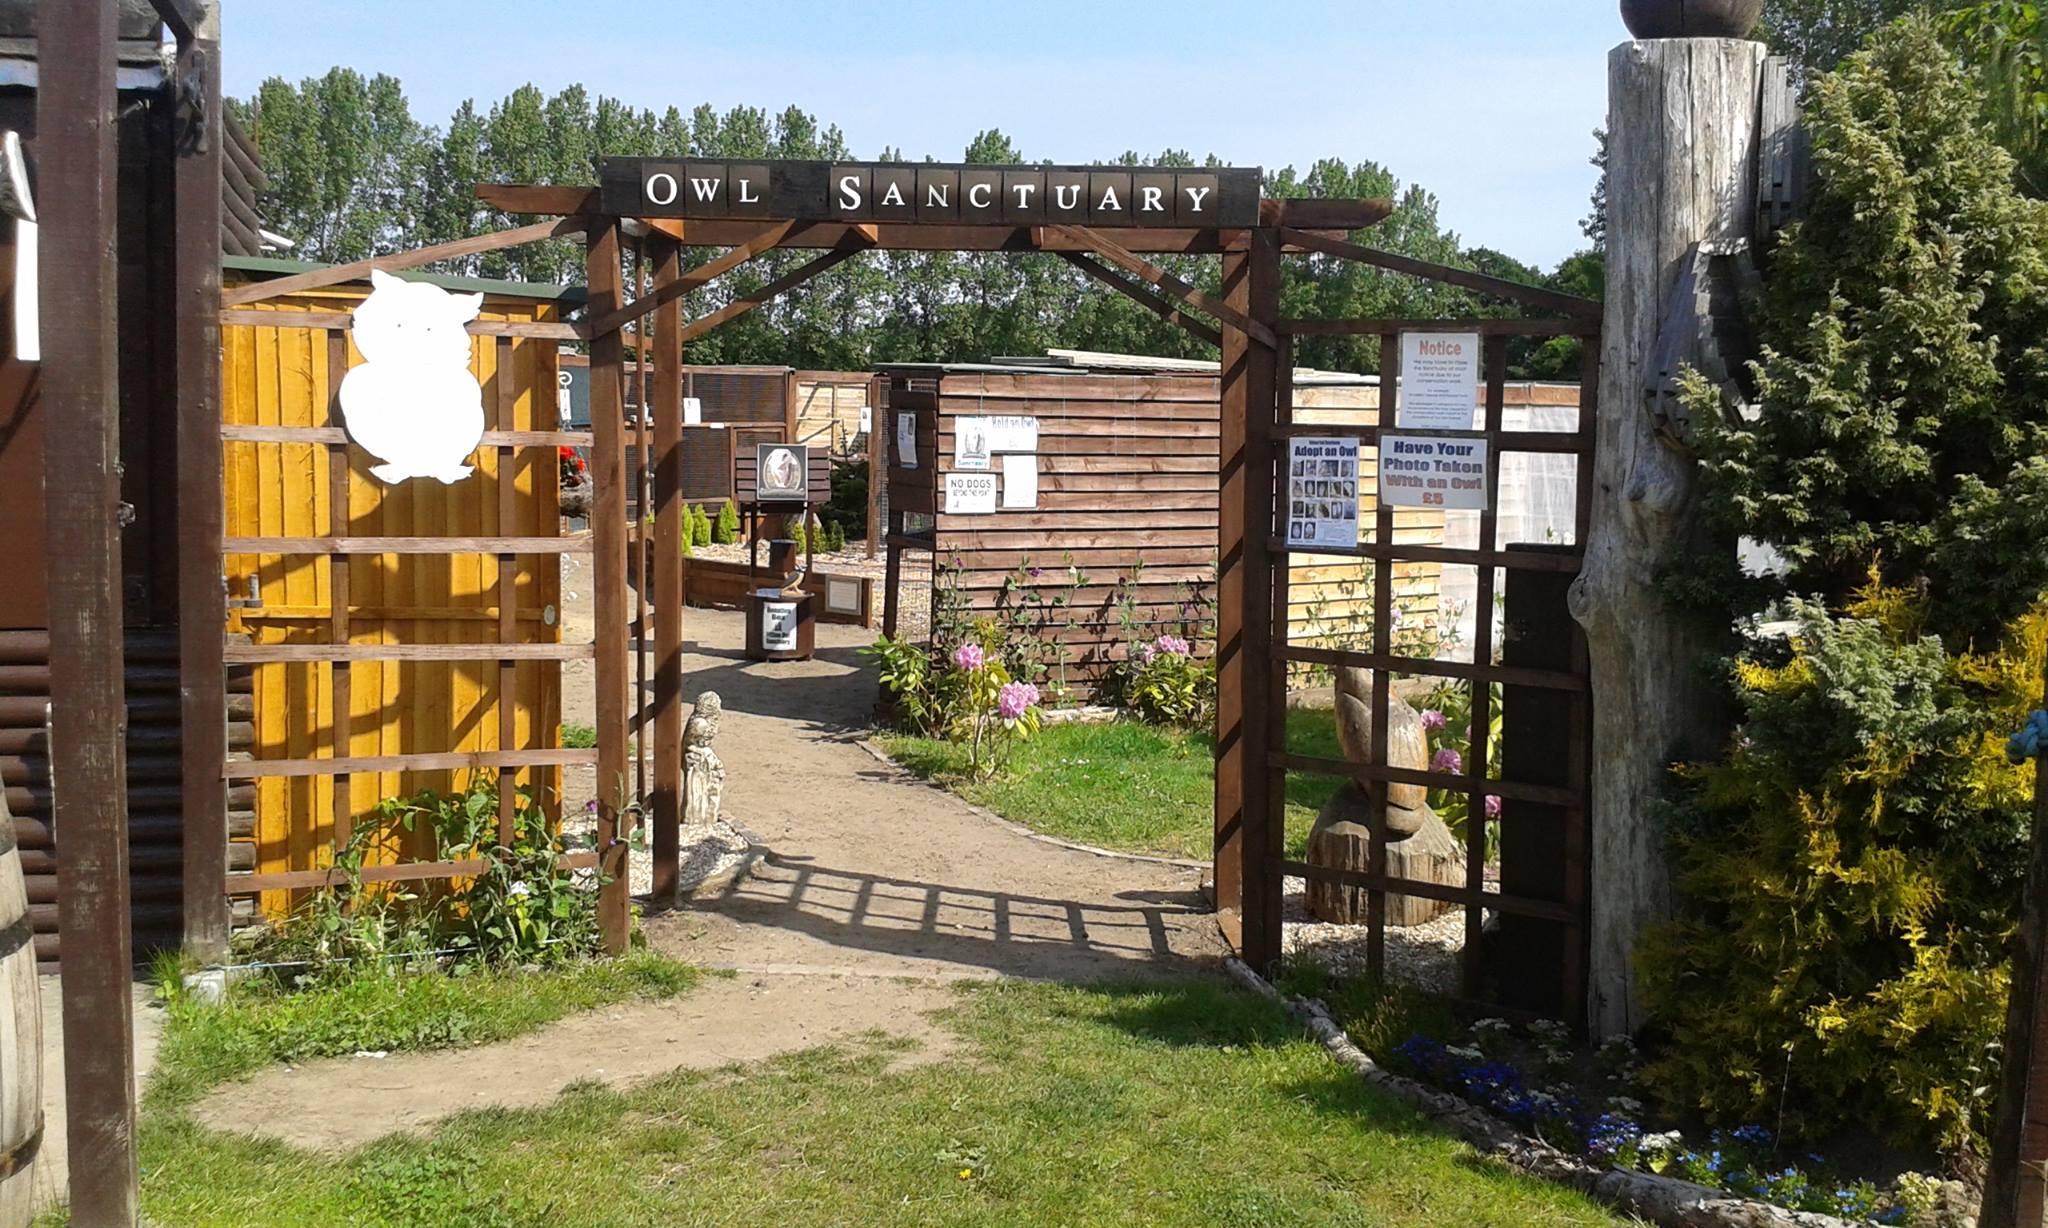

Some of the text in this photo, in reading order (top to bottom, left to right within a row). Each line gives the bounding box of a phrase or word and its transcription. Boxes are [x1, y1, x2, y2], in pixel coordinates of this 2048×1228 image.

[646, 173, 1209, 212] OWL SANCTUARY
[1419, 340, 1462, 356] Notice
[1295, 446, 1357, 457] Adopt an Owl
[1394, 441, 1474, 456] Have Your
[1384, 458, 1483, 474] Photo Taken
[950, 479, 992, 489] NO DOGS
[1385, 474, 1483, 490] With an Owl
[1422, 492, 1444, 505] £5
